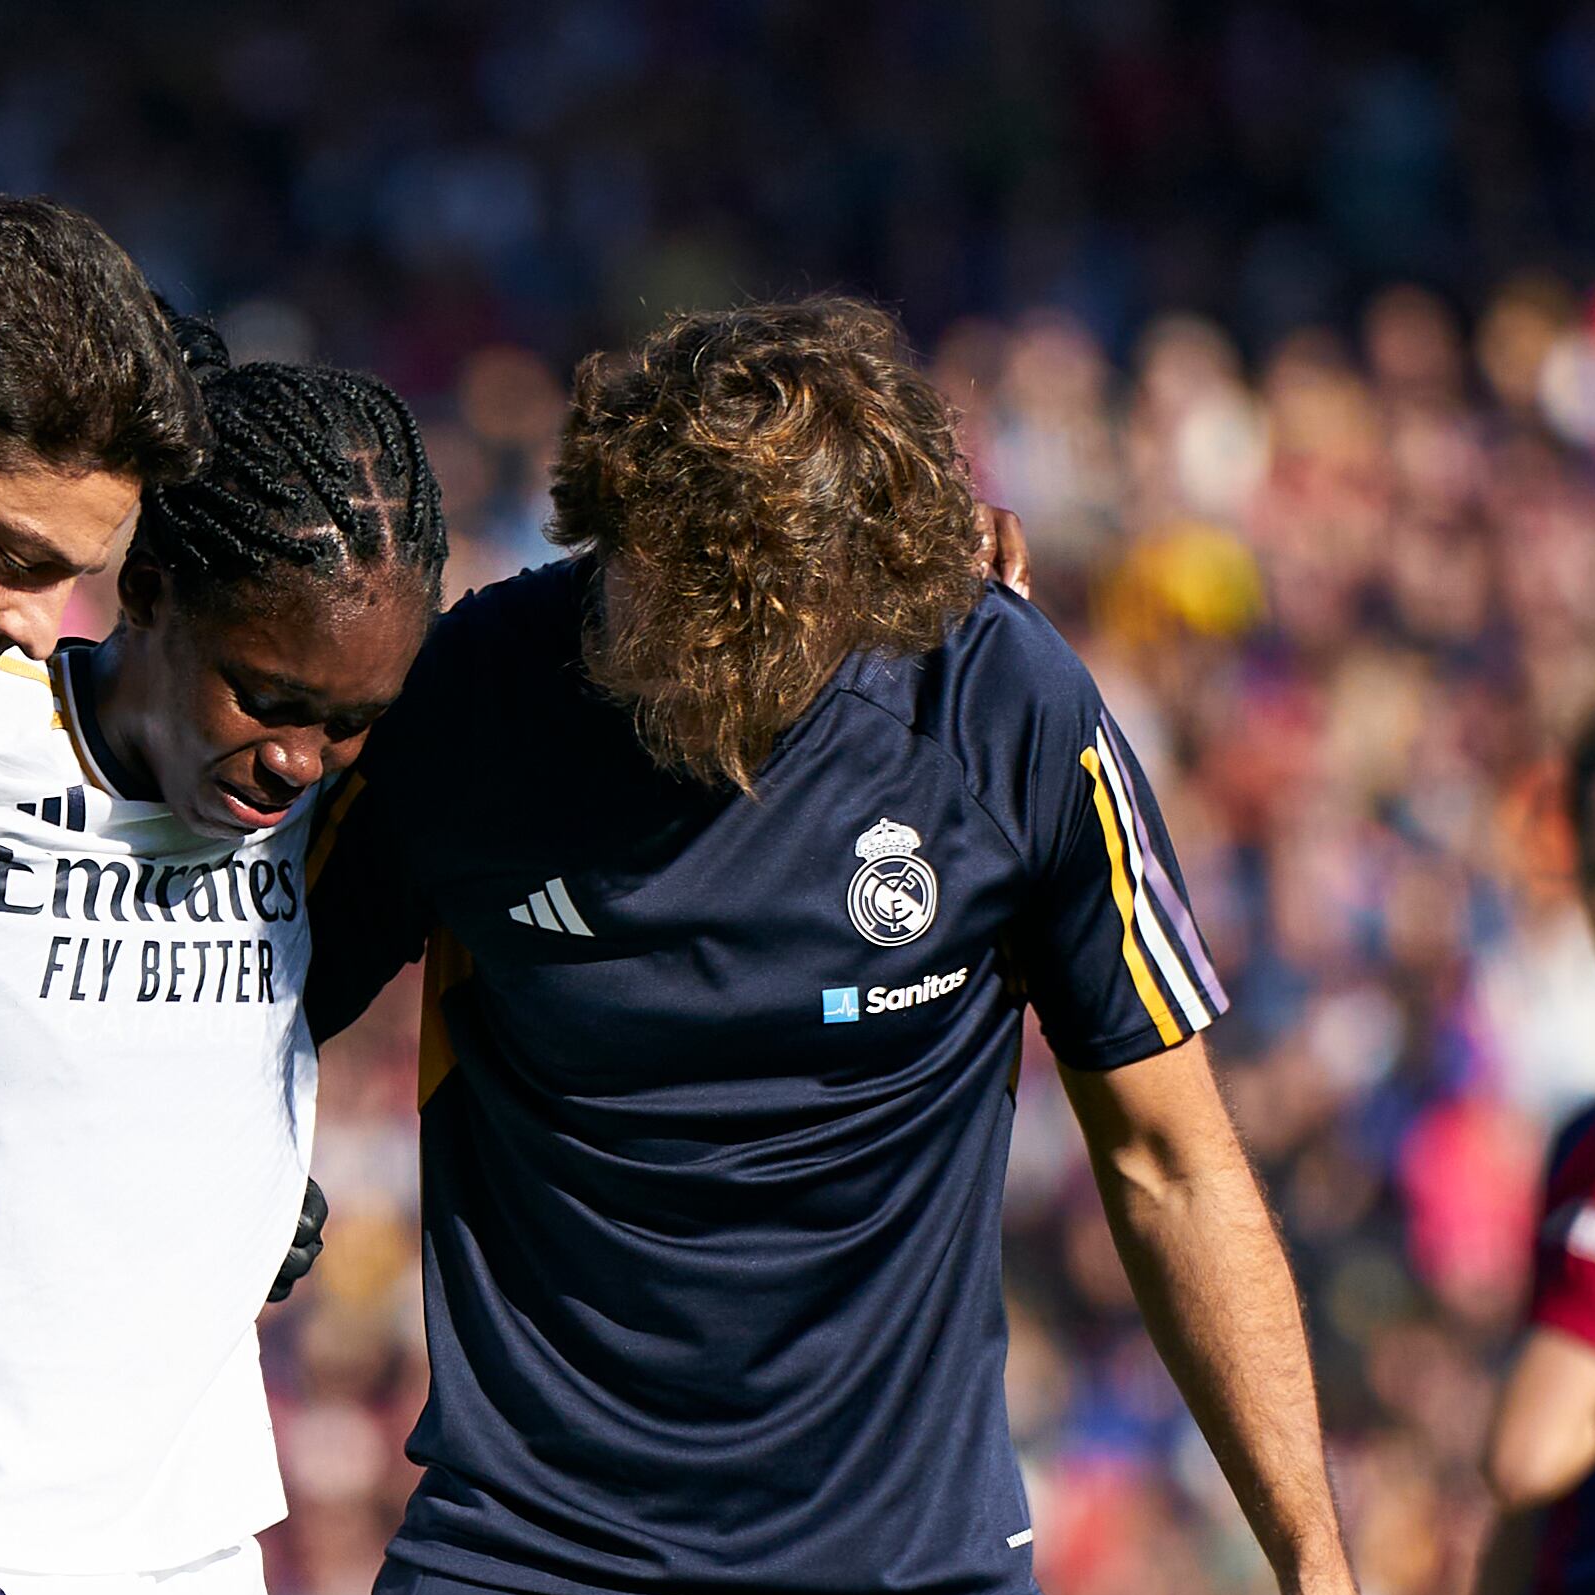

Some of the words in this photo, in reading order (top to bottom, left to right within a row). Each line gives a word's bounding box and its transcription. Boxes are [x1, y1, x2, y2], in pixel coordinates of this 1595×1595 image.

[39, 935, 123, 1001] FLY
[137, 939, 275, 1004] BETTER
[865, 966, 968, 1014] Sanitas
